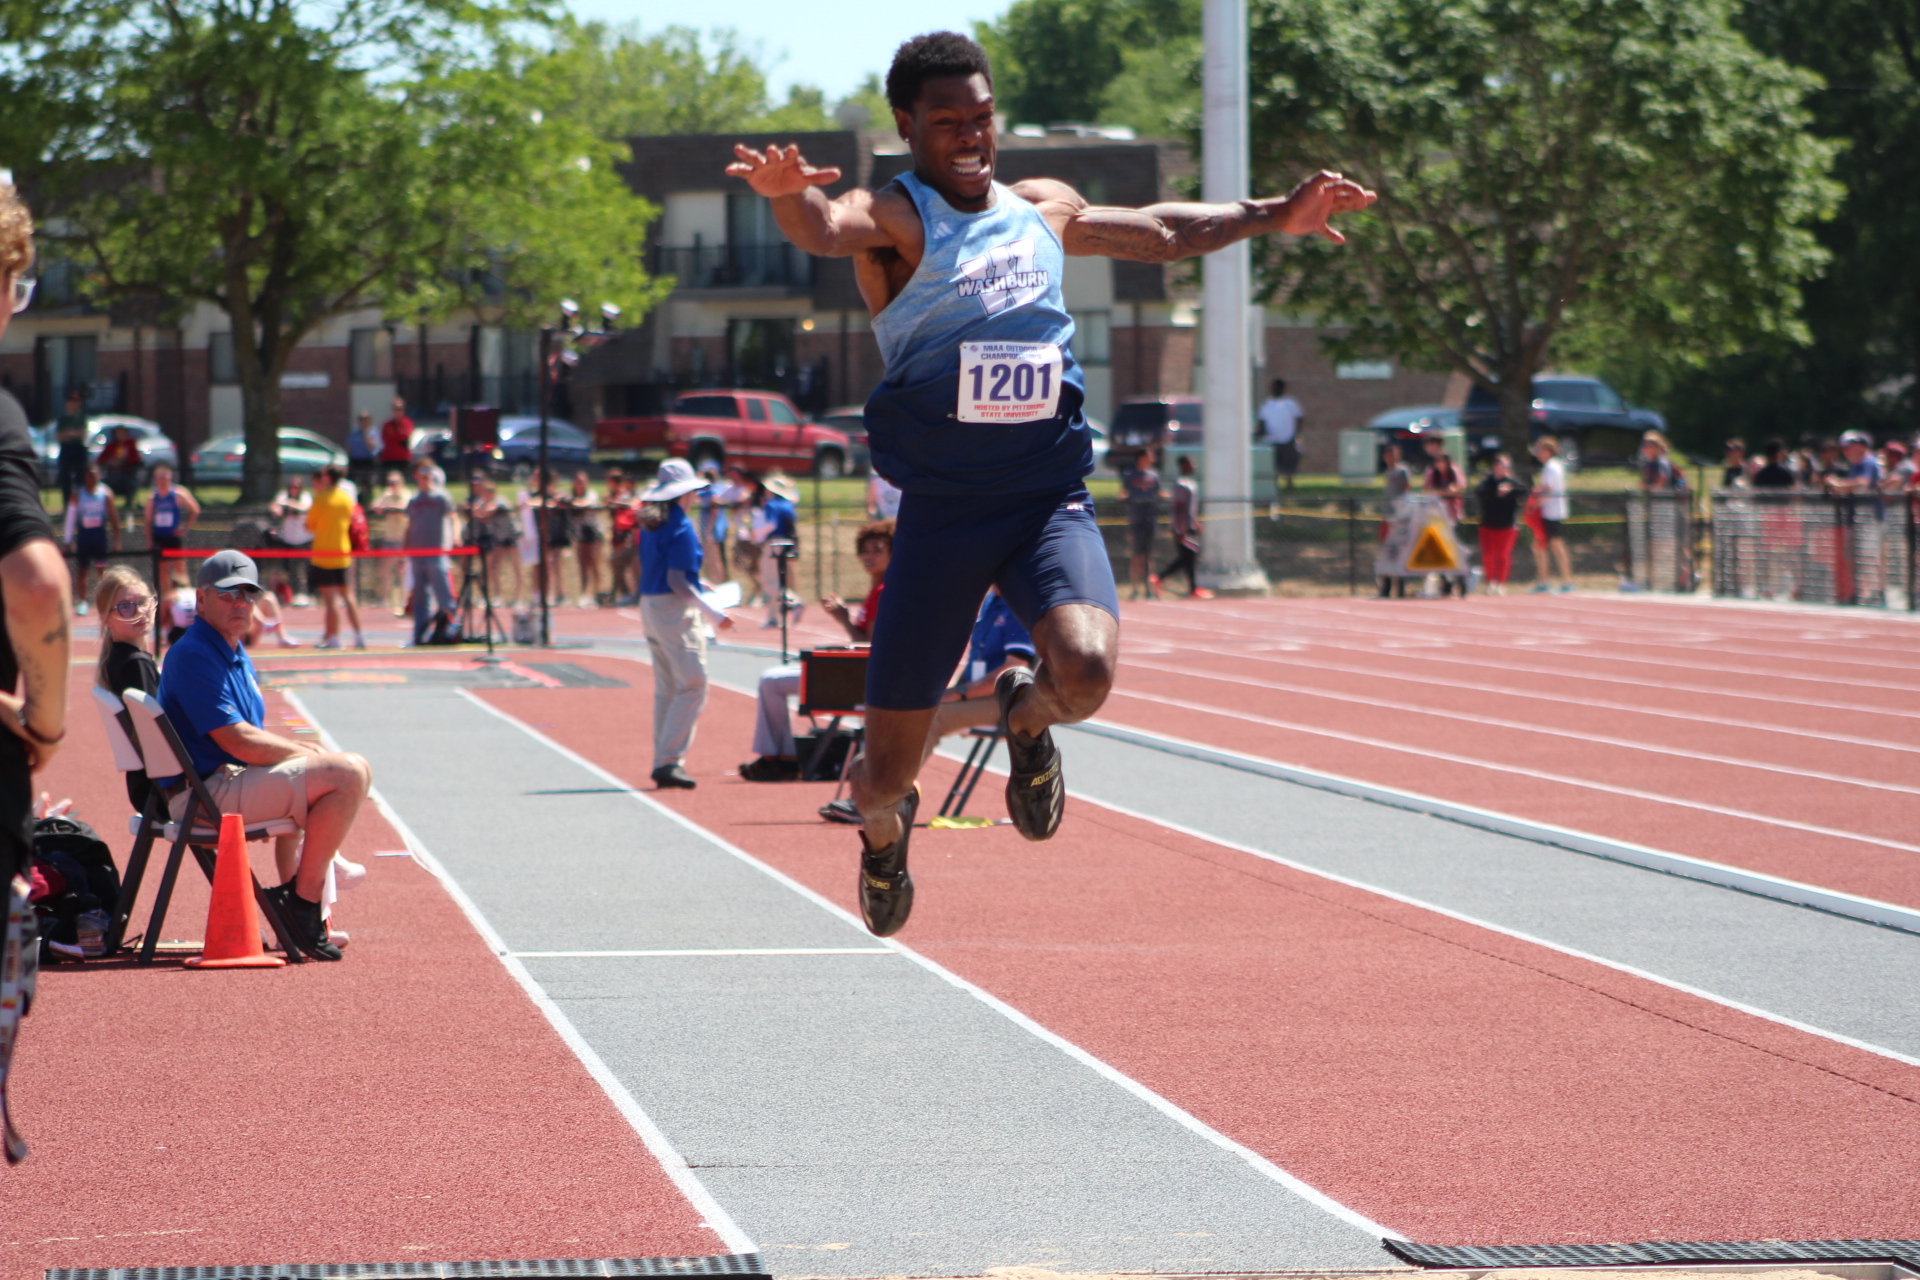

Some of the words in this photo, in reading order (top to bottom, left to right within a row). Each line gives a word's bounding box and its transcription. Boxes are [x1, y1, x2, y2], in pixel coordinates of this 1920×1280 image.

[957, 270, 1050, 298] WASHBURN
[1006, 345, 1037, 353] OUTDOOR
[968, 363, 1051, 402] 1201
[1012, 403, 1045, 411] PITTSBURG
